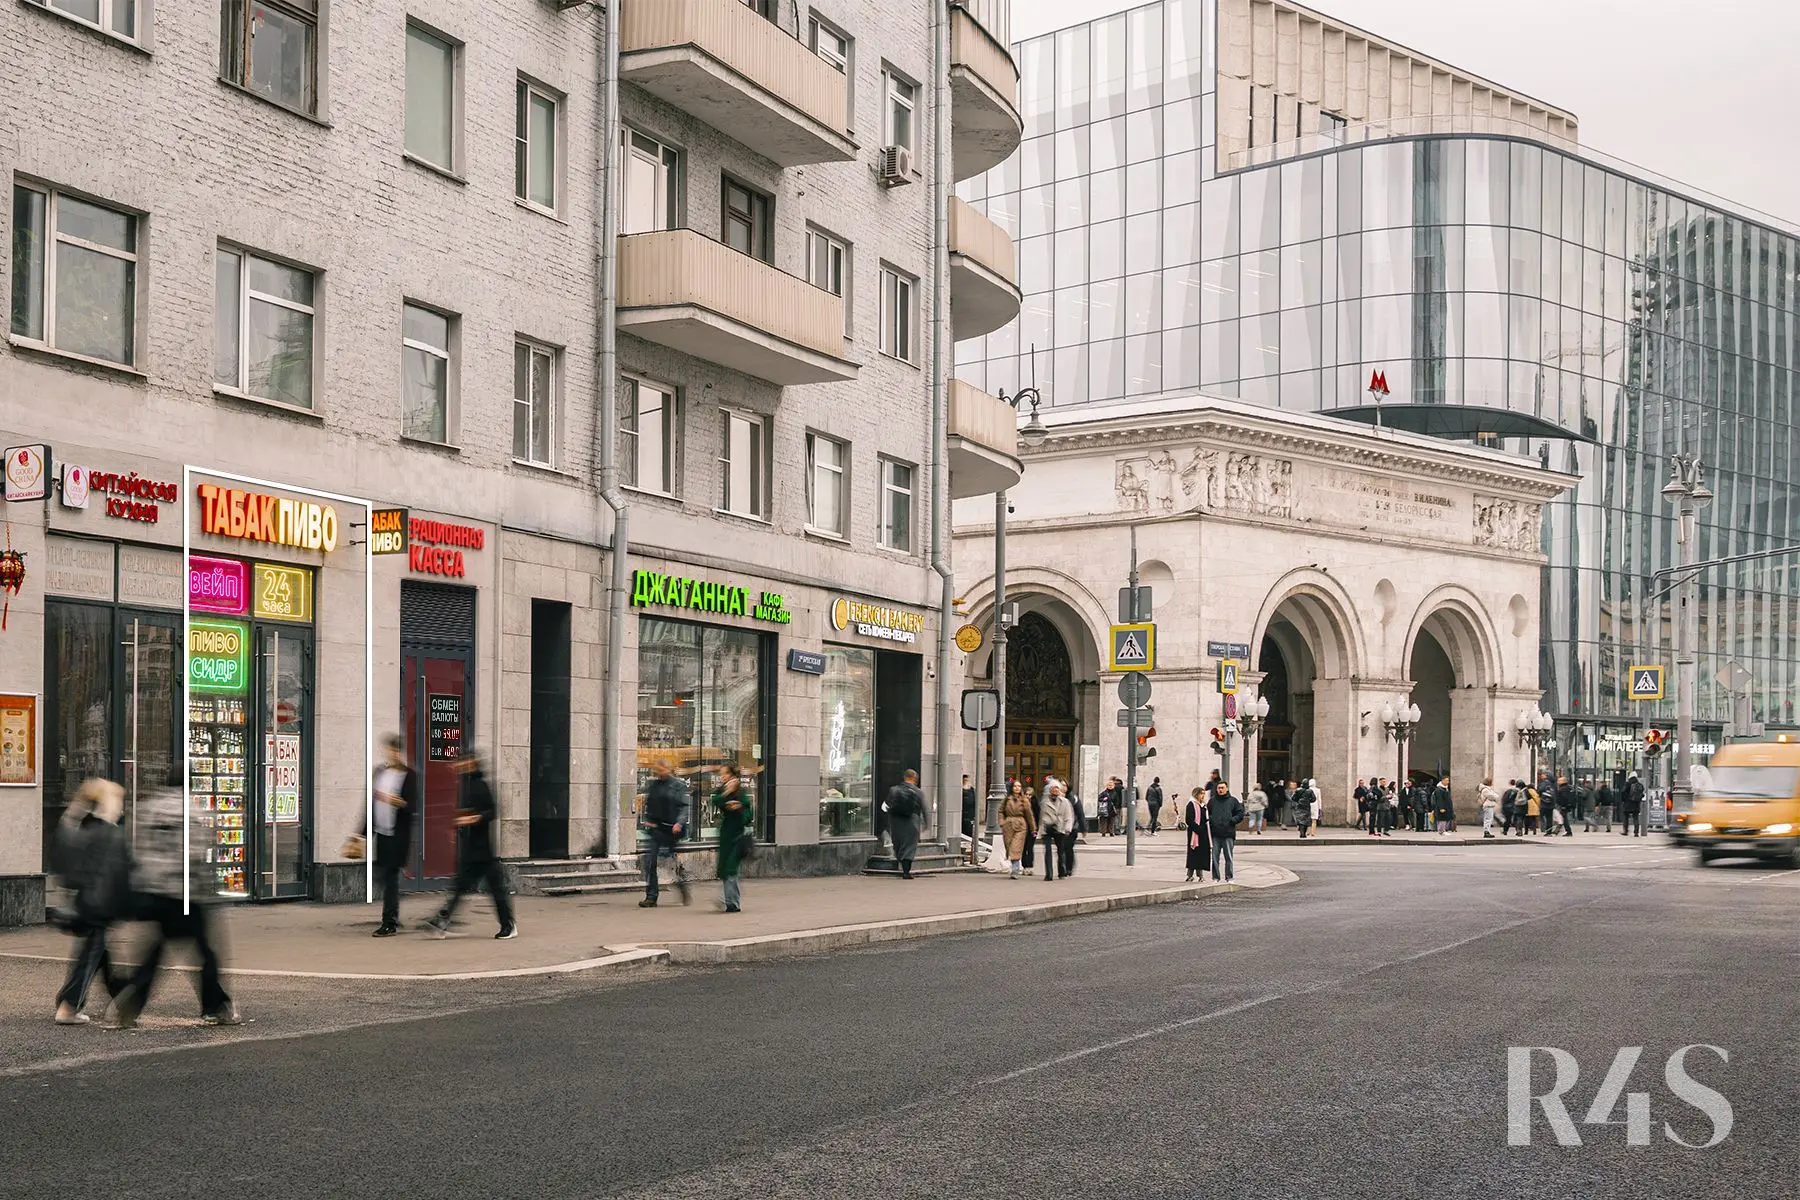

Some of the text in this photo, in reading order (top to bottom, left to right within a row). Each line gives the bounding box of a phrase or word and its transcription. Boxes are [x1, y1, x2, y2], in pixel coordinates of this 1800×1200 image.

[89, 470, 178, 503] КИТАЙСКАЯ
[106, 497, 158, 524] КУХНЯ
[198, 483, 338, 552] ТАБАК ПИВО
[409, 543, 465, 578] КАССА
[190, 567, 238, 598] ВЕЙП
[263, 569, 291, 602] 24
[630, 569, 750, 617] ДЖАГАННАТ
[262, 600, 292, 614] часа
[761, 591, 785, 609] КАФЕ
[753, 605, 792, 625] МАГАЗИН
[848, 601, 925, 633] FRENCH BAKERY
[190, 630, 239, 655] ПИВО
[191, 657, 238, 682] СИДР
[431, 699, 459, 712] ОБМЕН
[431, 712, 459, 723] ВАЛЮТЫ
[1613, 741, 1644, 752] ГАЛЕРЕ
